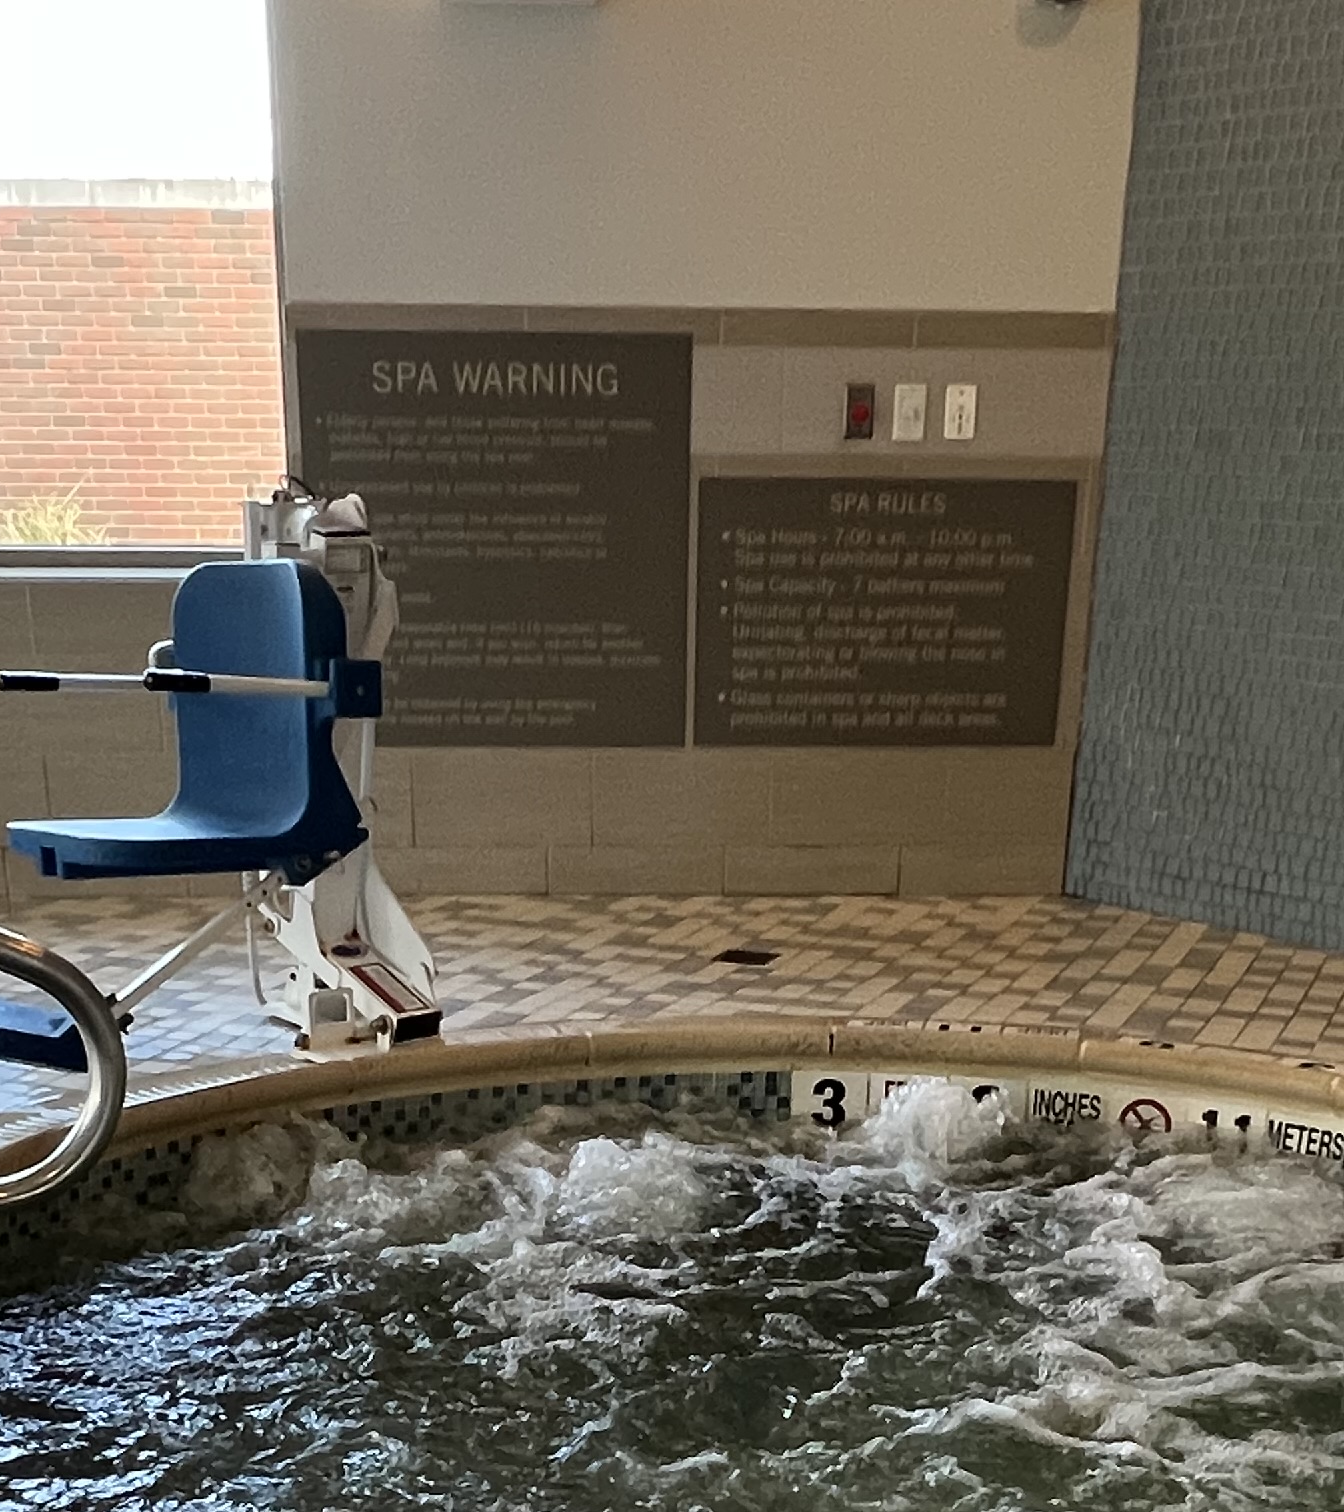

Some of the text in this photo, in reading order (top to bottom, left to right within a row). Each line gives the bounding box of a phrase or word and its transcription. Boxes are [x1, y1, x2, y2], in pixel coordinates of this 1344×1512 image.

[372, 360, 619, 397] SPA WARNING
[830, 492, 947, 514] SPA RULES
[811, 1079, 847, 1126] 3
[1033, 1088, 1102, 1120] INCHES
